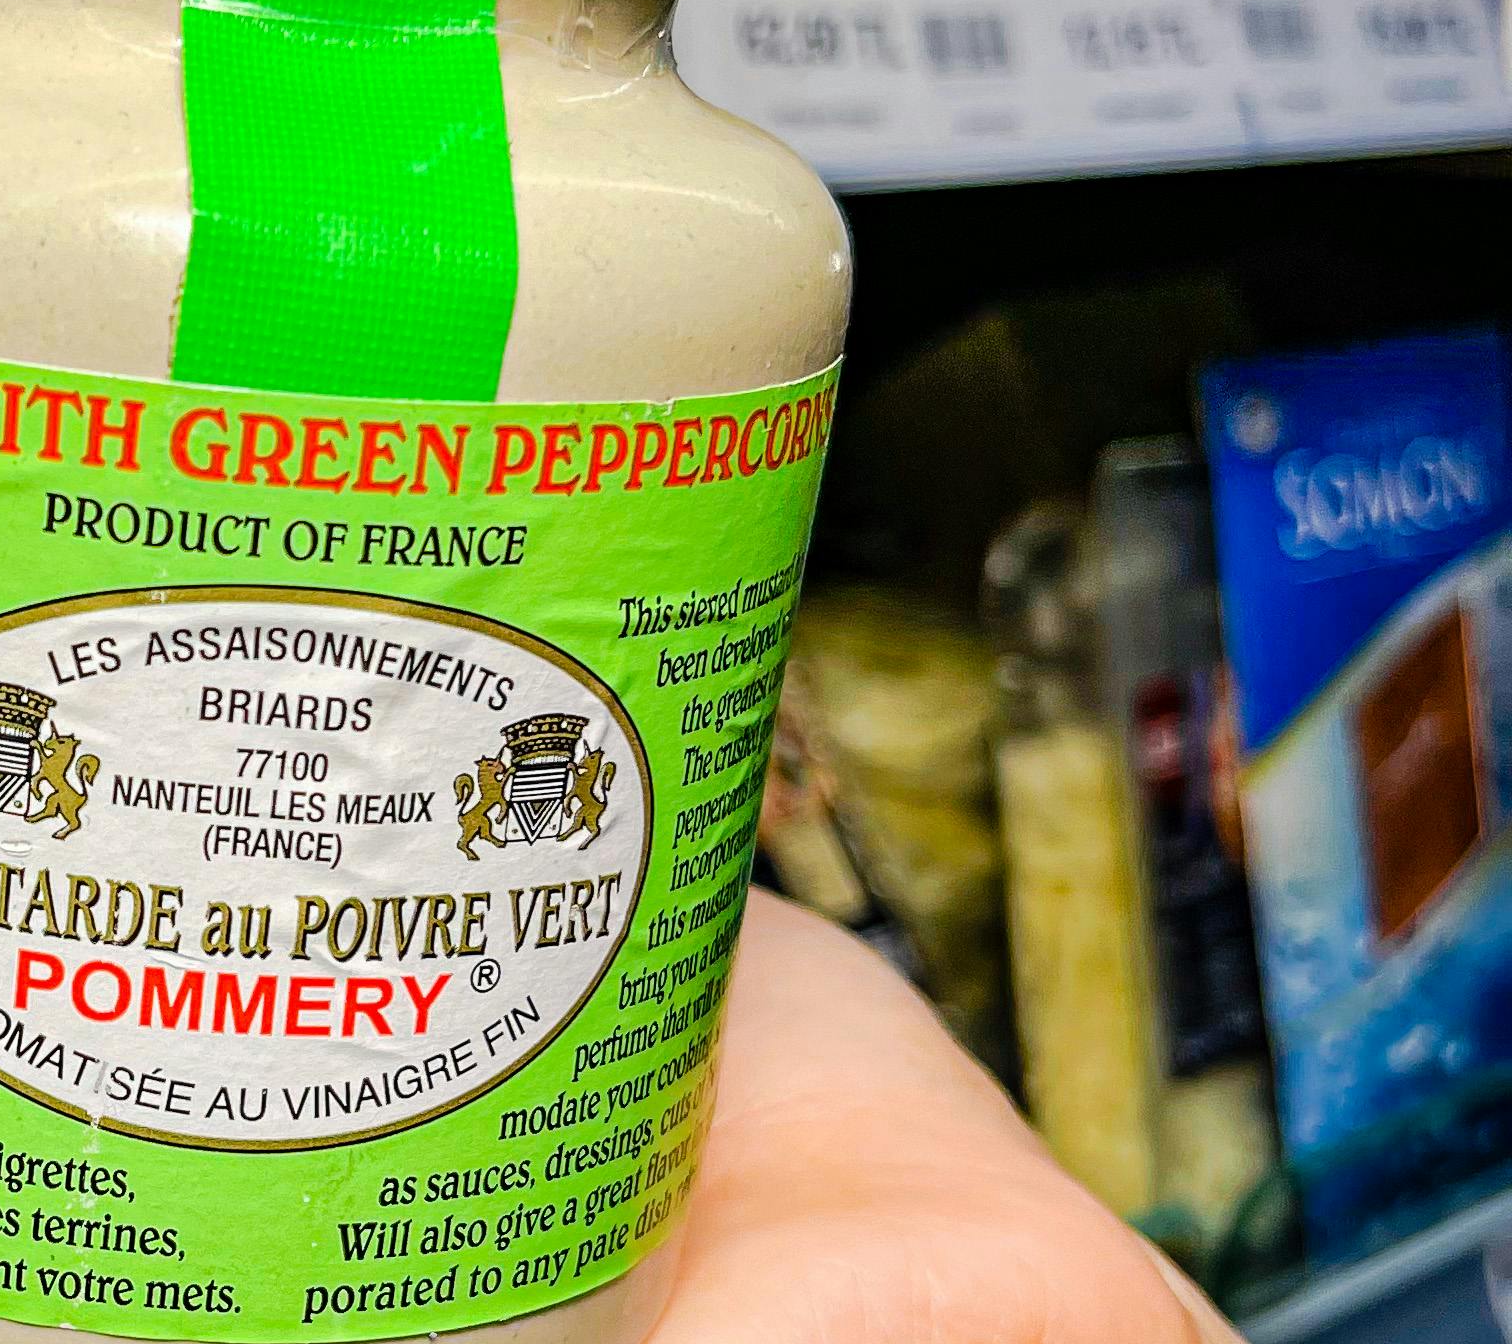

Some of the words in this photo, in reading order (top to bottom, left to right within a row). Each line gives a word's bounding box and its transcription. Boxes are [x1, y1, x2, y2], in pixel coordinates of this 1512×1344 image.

[170, 406, 470, 498] GREEN
[42, 491, 270, 558] PRODUCT
[283, 519, 347, 563] OF
[358, 523, 529, 568] FRANCE
[618, 594, 674, 640] This
[674, 576, 743, 631] sieved
[46, 645, 124, 688] LES
[144, 626, 516, 713] ASSAISONNEMENTS
[656, 647, 708, 689] been
[198, 685, 375, 734] BRIARDS
[681, 694, 714, 736] the
[235, 747, 330, 783] 77100
[681, 745, 714, 787] The
[111, 774, 262, 820] NANTEUIL
[269, 791, 327, 825] LES
[335, 789, 438, 824] MEAUX
[202, 822, 345, 870] (FRANCE)
[200, 889, 272, 959] au
[294, 888, 493, 962] POIVRE
[508, 870, 623, 953] VERT
[648, 905, 687, 952] this
[12, 947, 456, 1038] POMMERY
[618, 963, 669, 1010] bring
[668, 951, 699, 1000] you
[699, 944, 709, 973] a
[204, 1086, 271, 1125] AU
[281, 1045, 479, 1122] VINAIGRE
[483, 994, 542, 1064] FIN
[572, 1022, 659, 1083] perfume
[661, 997, 691, 1044] that
[498, 1090, 602, 1141] modate
[603, 1069, 656, 1125] your
[378, 1175, 417, 1208] as
[424, 1158, 537, 1204] sauces,
[545, 1118, 655, 1183] dressings,
[31, 1206, 188, 1263] terrines,
[337, 1217, 410, 1263] Will
[419, 1215, 488, 1257] also
[496, 1201, 555, 1252] give
[561, 1196, 578, 1226] a
[584, 1164, 644, 1227] great
[36, 1262, 135, 1307] votre
[145, 1274, 243, 1315] mets.
[302, 1263, 459, 1324] porated
[468, 1262, 503, 1299] to
[511, 1246, 571, 1288] any
[572, 1222, 630, 1278] pate
[634, 1188, 672, 1241] dish
